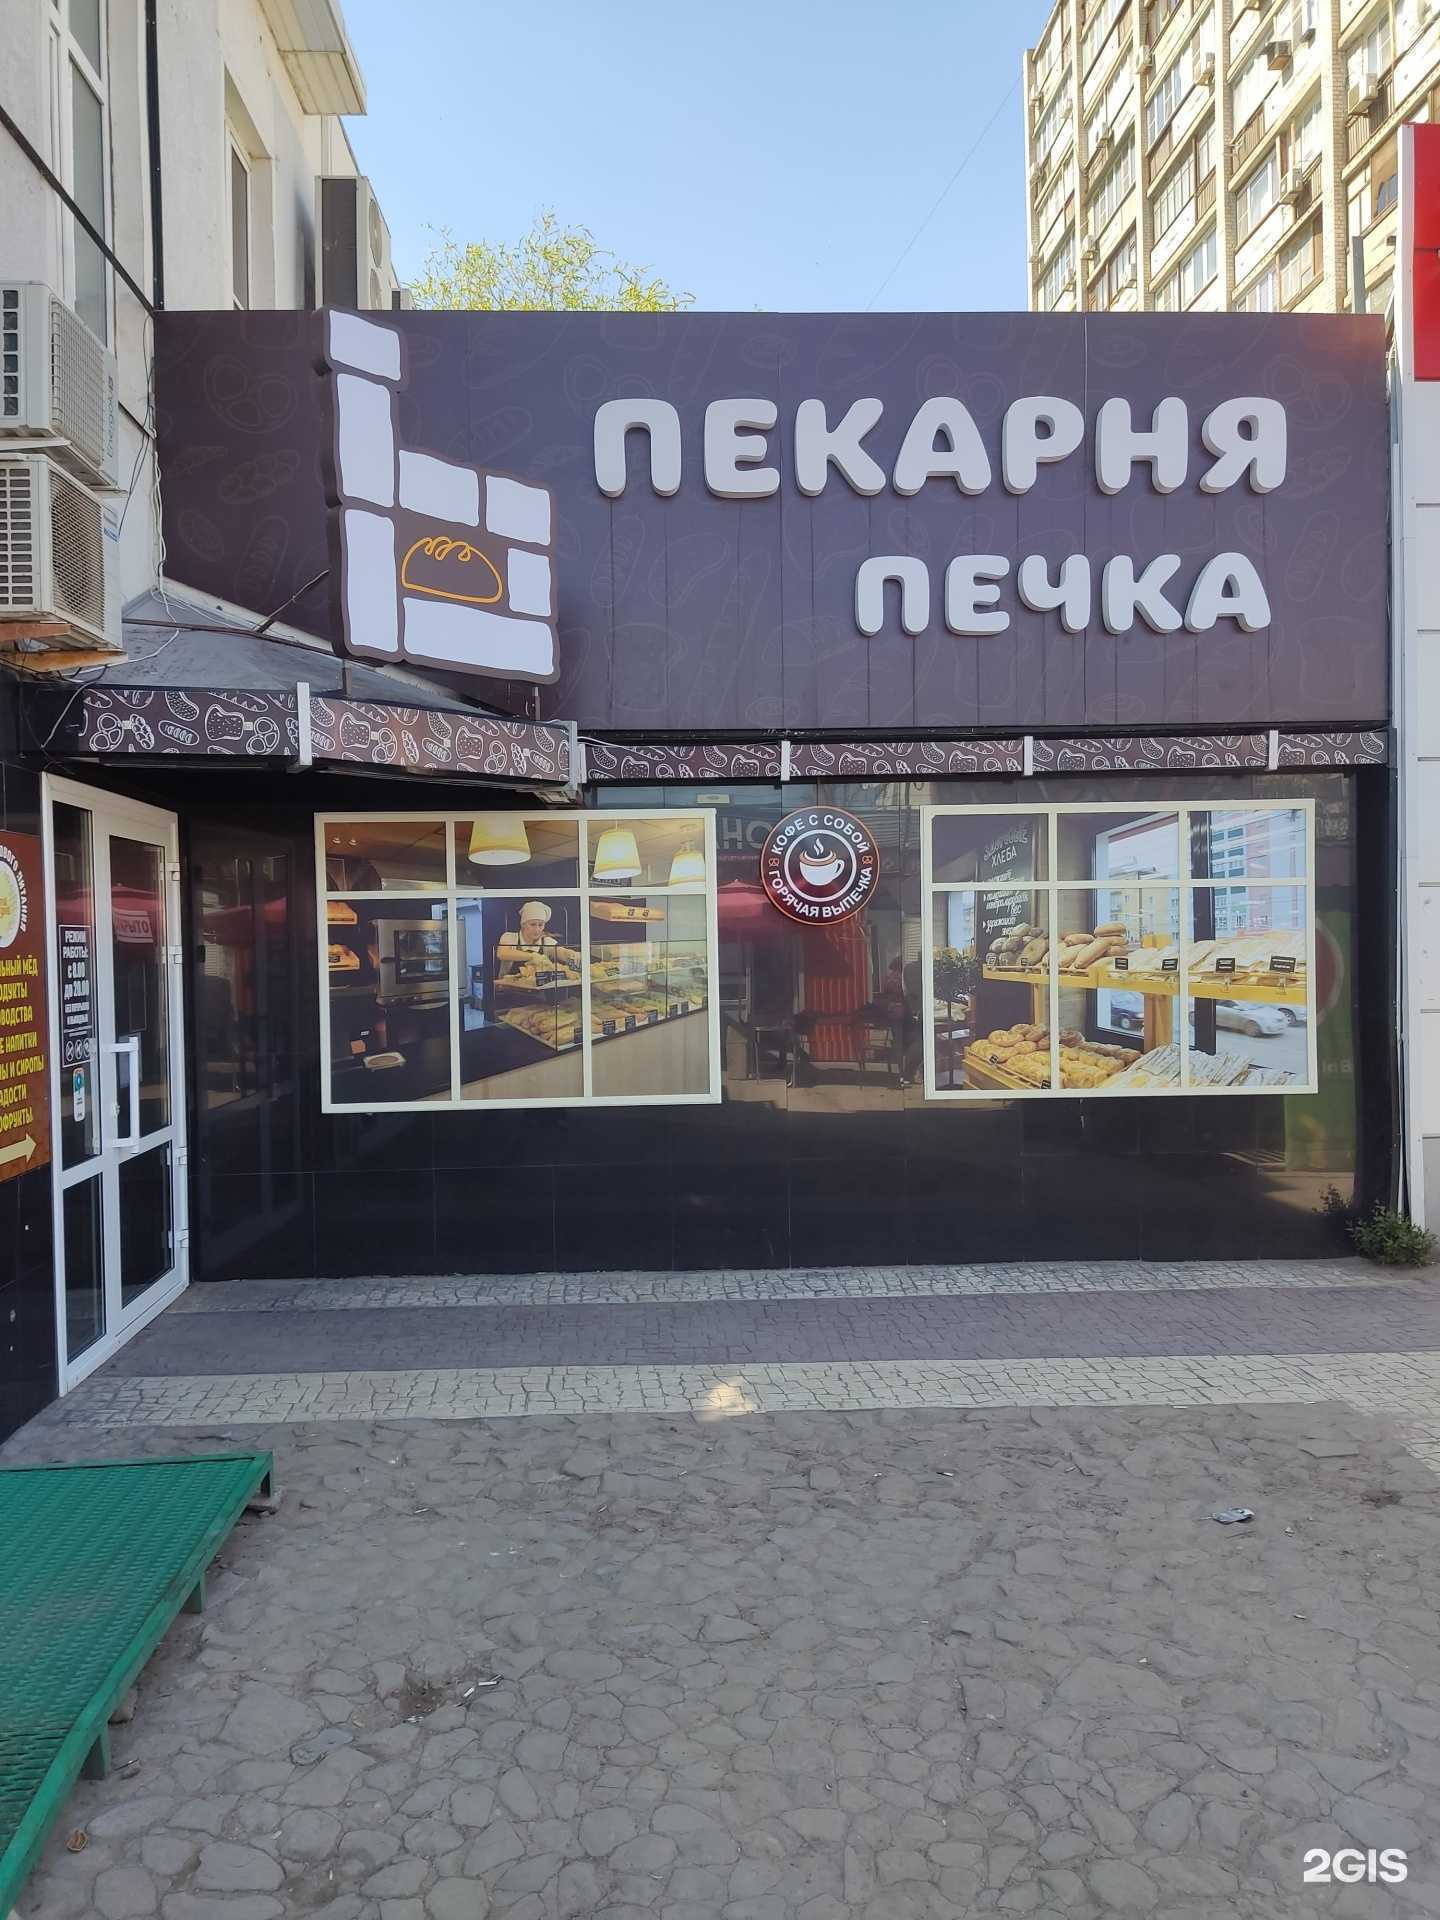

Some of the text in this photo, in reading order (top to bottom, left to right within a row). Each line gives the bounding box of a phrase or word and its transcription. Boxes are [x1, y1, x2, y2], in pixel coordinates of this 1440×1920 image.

[593, 395, 1288, 498] ПЕКАРНЯ
[854, 552, 1271, 636] ПЕЧКА
[770, 817, 806, 855] КОФЕ
[808, 813, 819, 826] С
[823, 813, 872, 853] СОБОЙ
[991, 846, 1017, 868] ХЛЕБА
[768, 866, 873, 918] ГОРЯЧАЯ ВЫПЕЧКА
[64, 930, 87, 944] РЕЖИМ
[62, 945, 89, 959] РАБОТЫ:
[22, 954, 39, 977] МЁД
[5, 1031, 38, 1053] НАПИТКИ
[9, 1060, 16, 1079] И
[16, 1054, 45, 1077] СИРОПЫ
